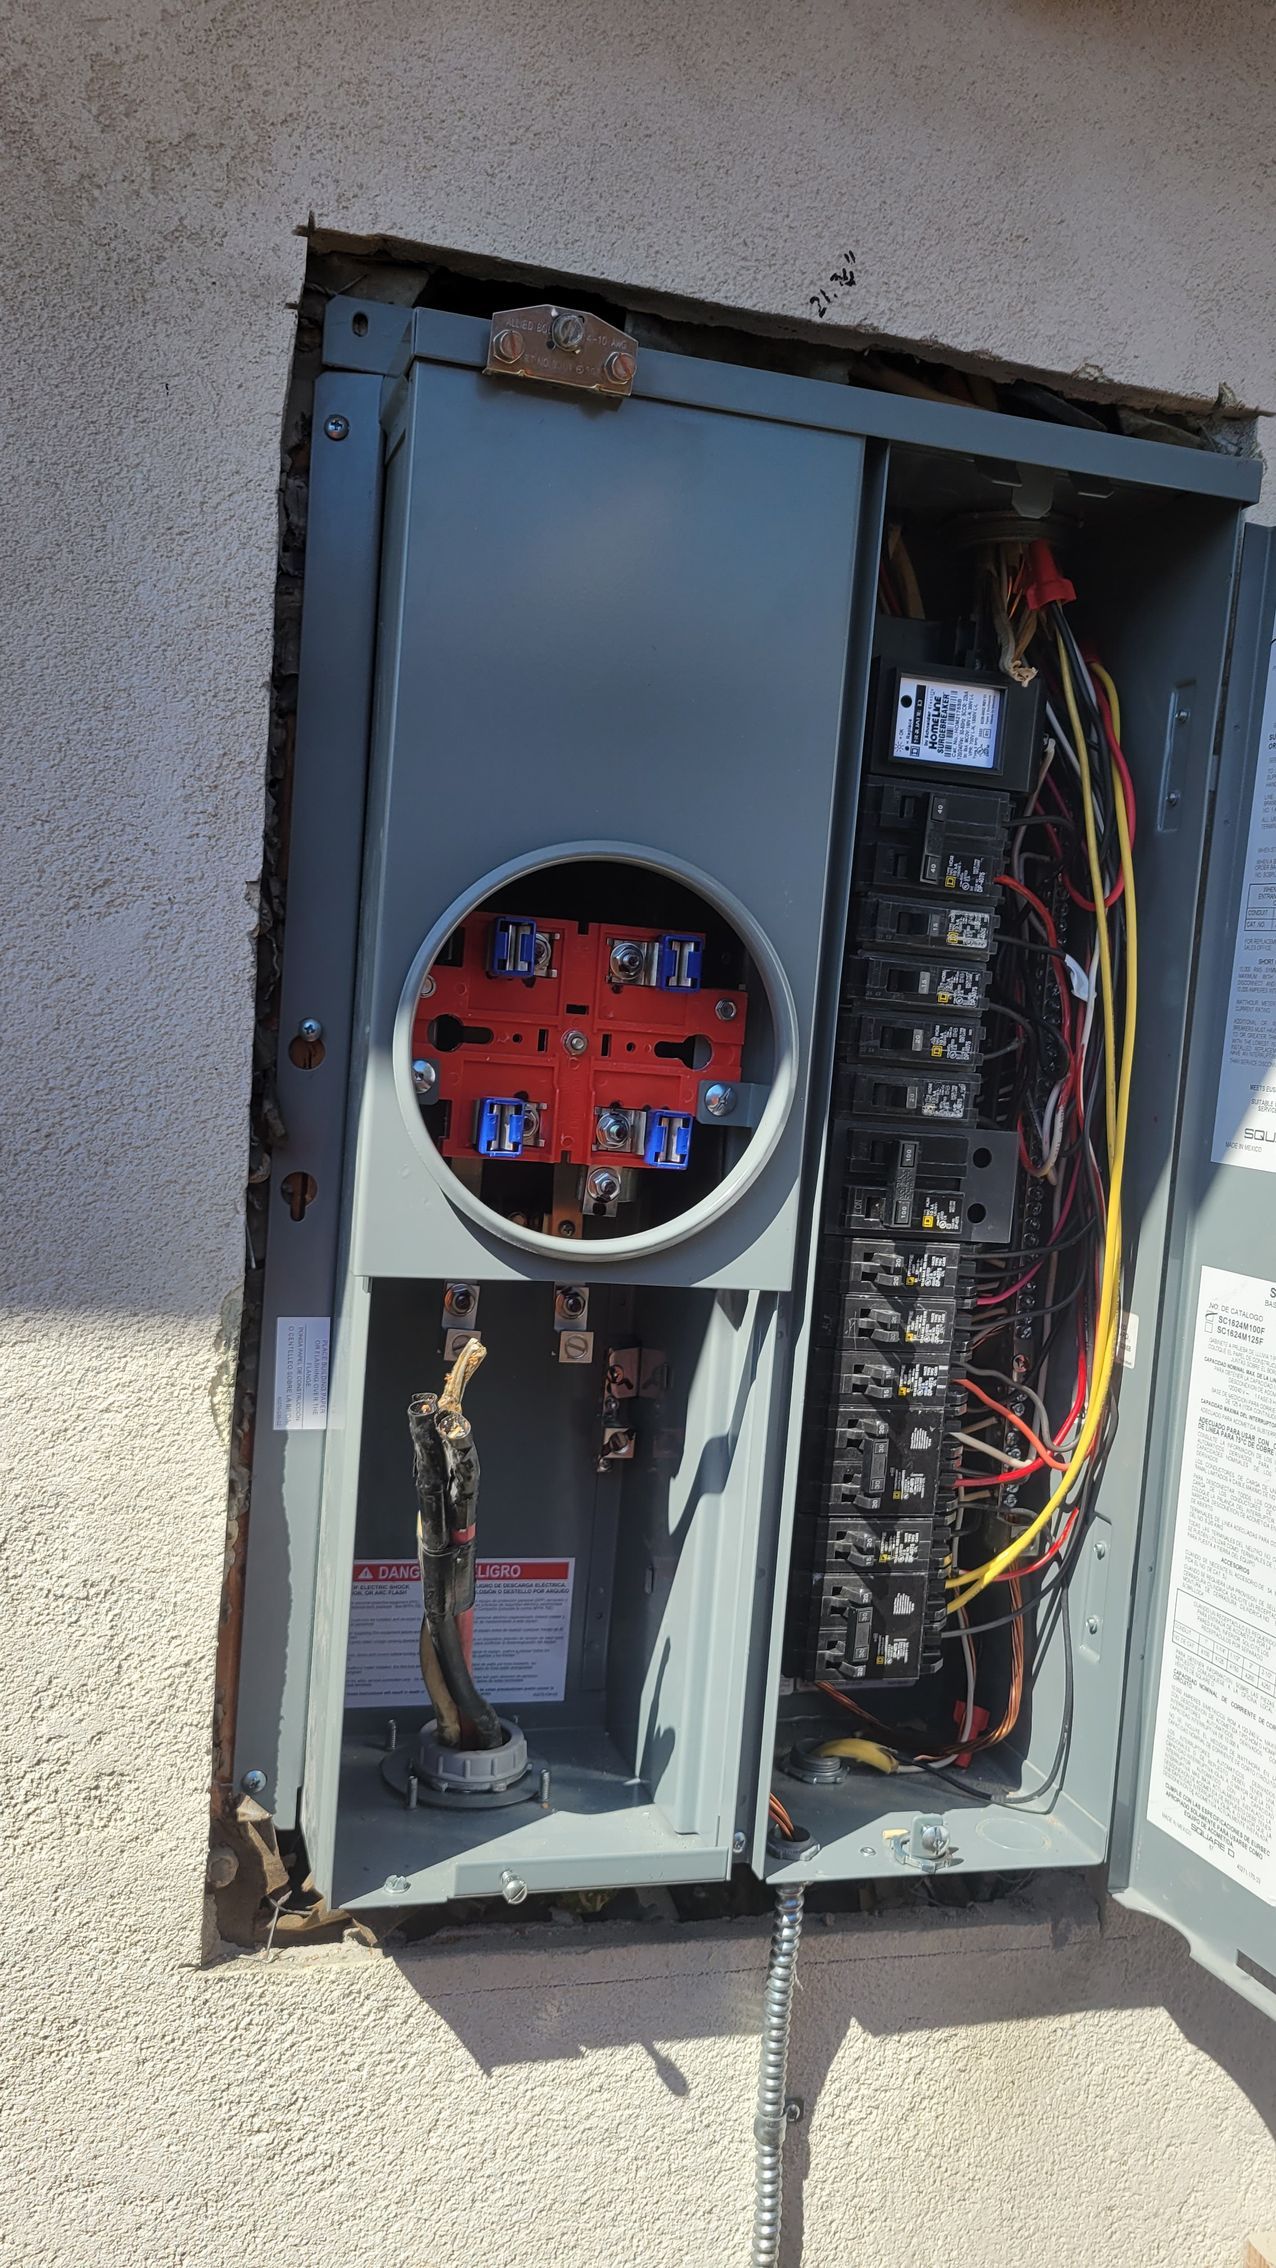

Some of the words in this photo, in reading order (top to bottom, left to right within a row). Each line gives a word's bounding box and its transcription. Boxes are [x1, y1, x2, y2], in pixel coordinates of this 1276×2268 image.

[505, 319, 533, 331] ALLIED
[937, 694, 949, 754] SURGEBREAKER
[937, 804, 944, 814] 40
[930, 863, 937, 873] 40
[895, 1258, 901, 1268] 20
[893, 1276, 899, 1286] 20
[320, 1362, 328, 1391] BUILDING
[879, 1425, 885, 1434] 20
[872, 1500, 878, 1509] 20
[378, 1565, 421, 1579] DANG
[475, 1564, 521, 1578] LIGRO
[1190, 1821, 1225, 1852] SQUARE
